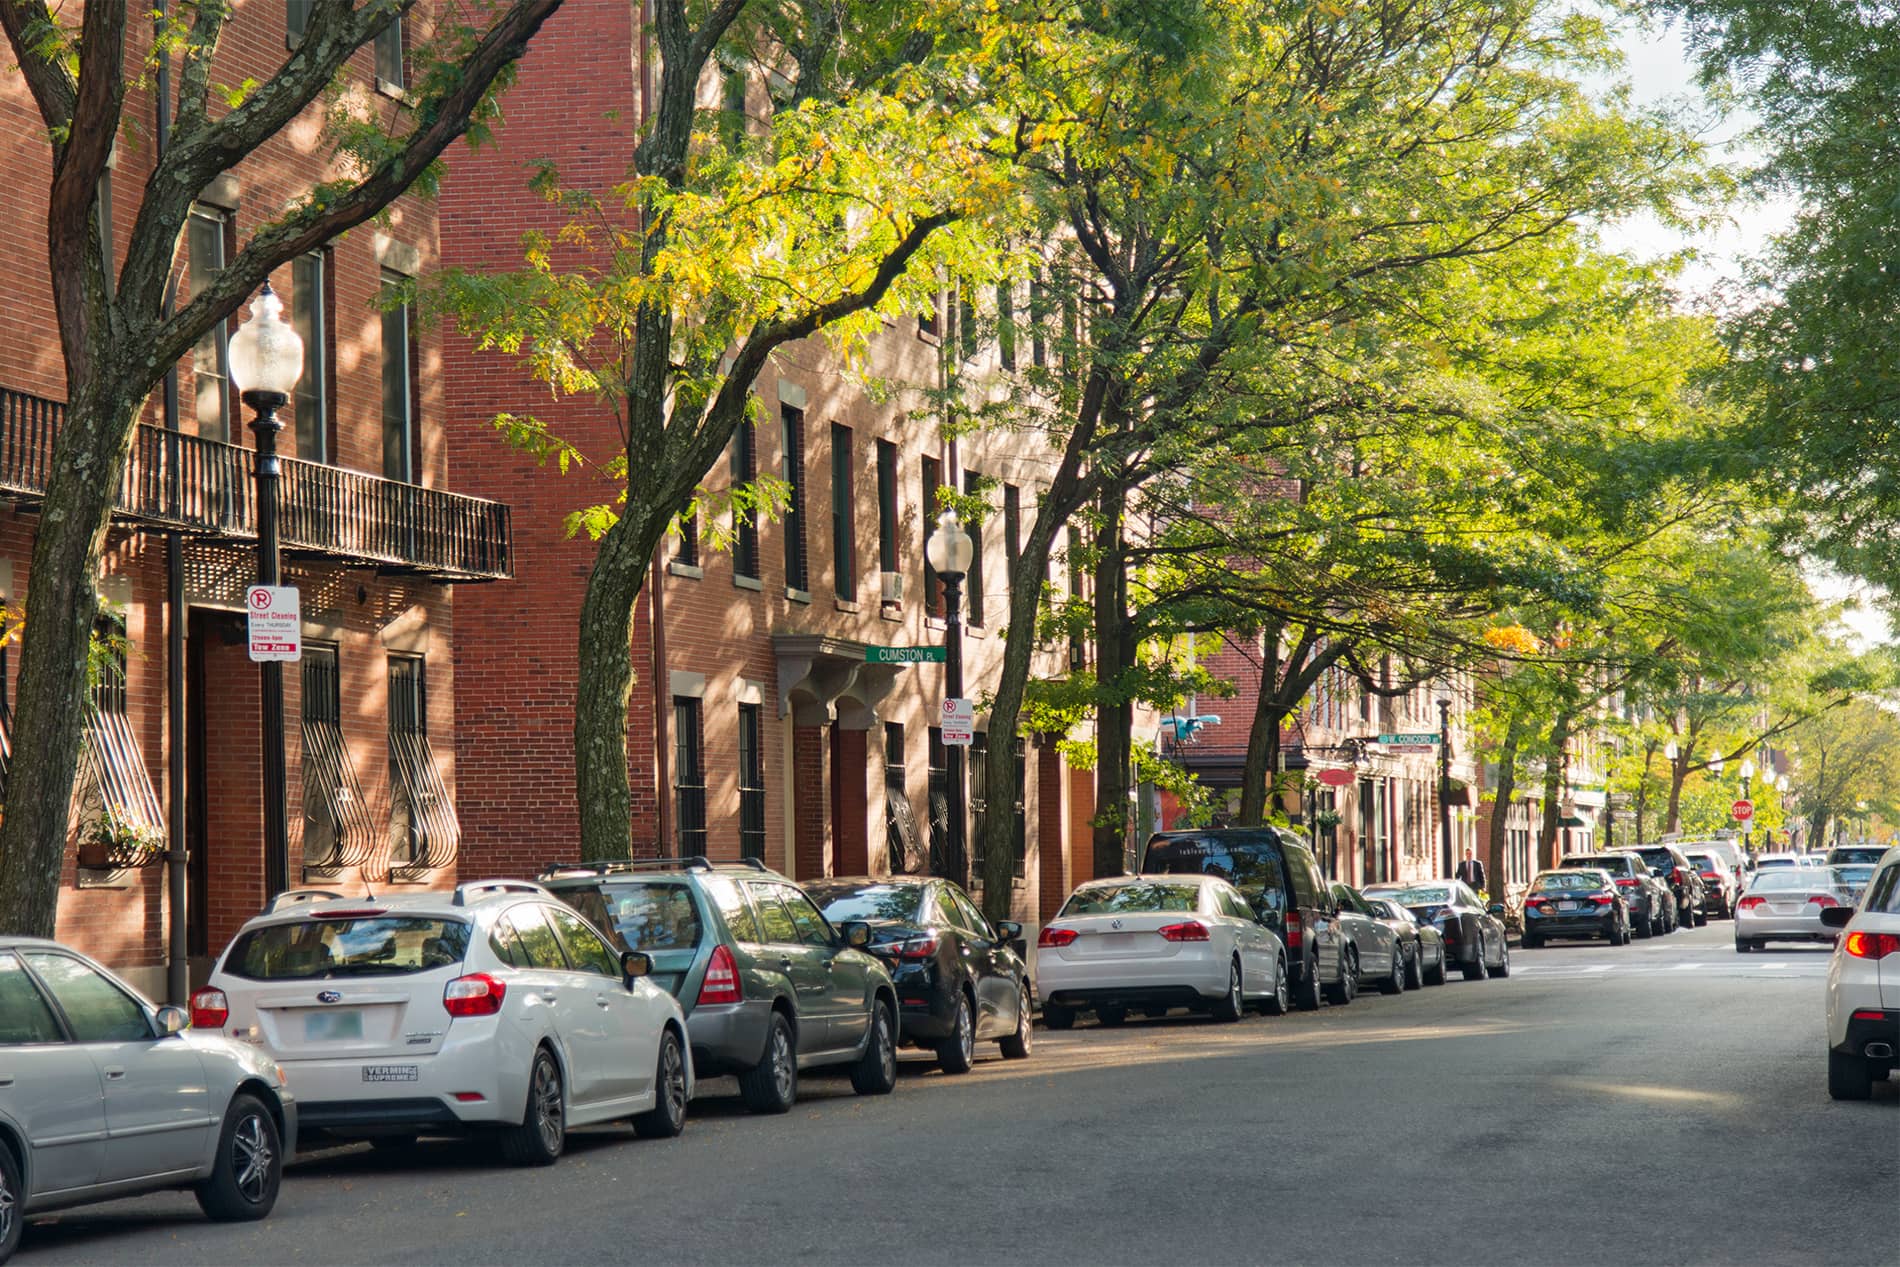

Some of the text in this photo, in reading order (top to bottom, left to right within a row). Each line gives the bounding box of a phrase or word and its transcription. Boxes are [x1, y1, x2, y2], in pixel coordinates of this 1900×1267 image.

[250, 612, 297, 621] Street Cleaning
[254, 643, 290, 652] Tow Zone
[879, 649, 935, 661] CUMSTON PL
[1733, 806, 1752, 815] STOP
[368, 1066, 409, 1074] VERMIN
